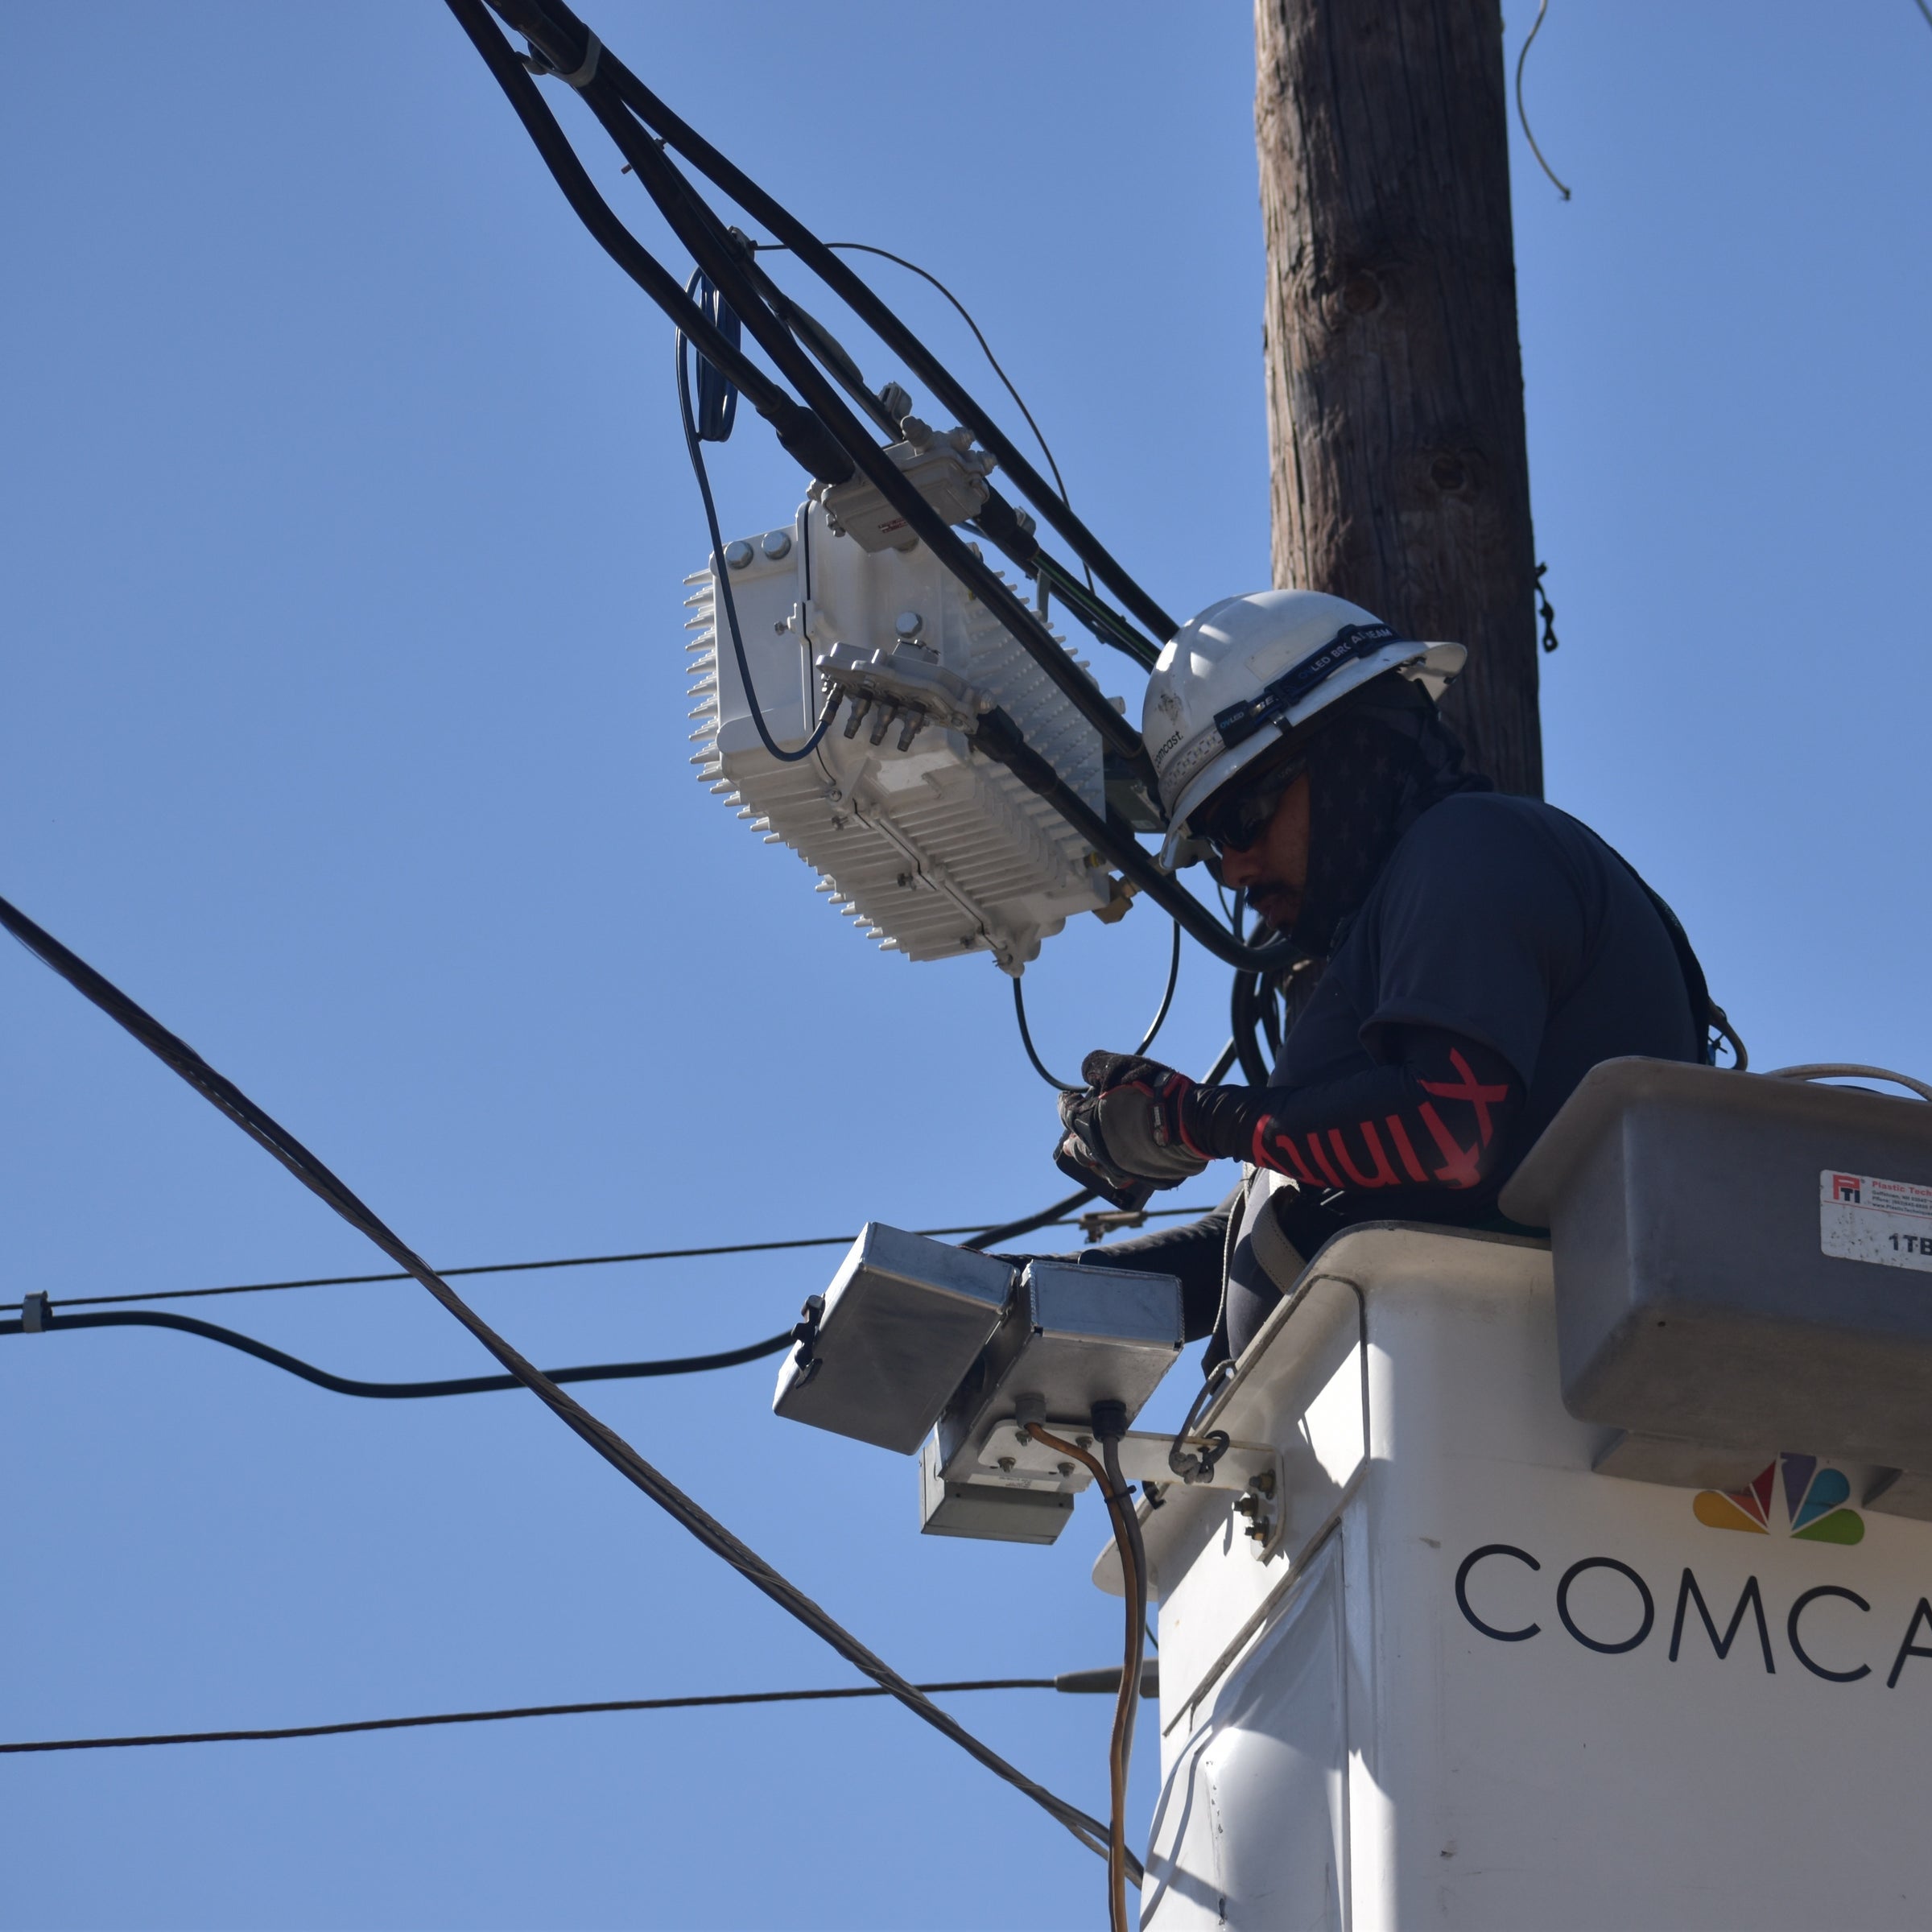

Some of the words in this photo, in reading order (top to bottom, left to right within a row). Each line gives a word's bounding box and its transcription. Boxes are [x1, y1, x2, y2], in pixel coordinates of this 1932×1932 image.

[1833, 1174, 1860, 1203] PTI
[1872, 1180, 1905, 1193] Plastic
[1889, 1233, 1932, 1256] 1TB
